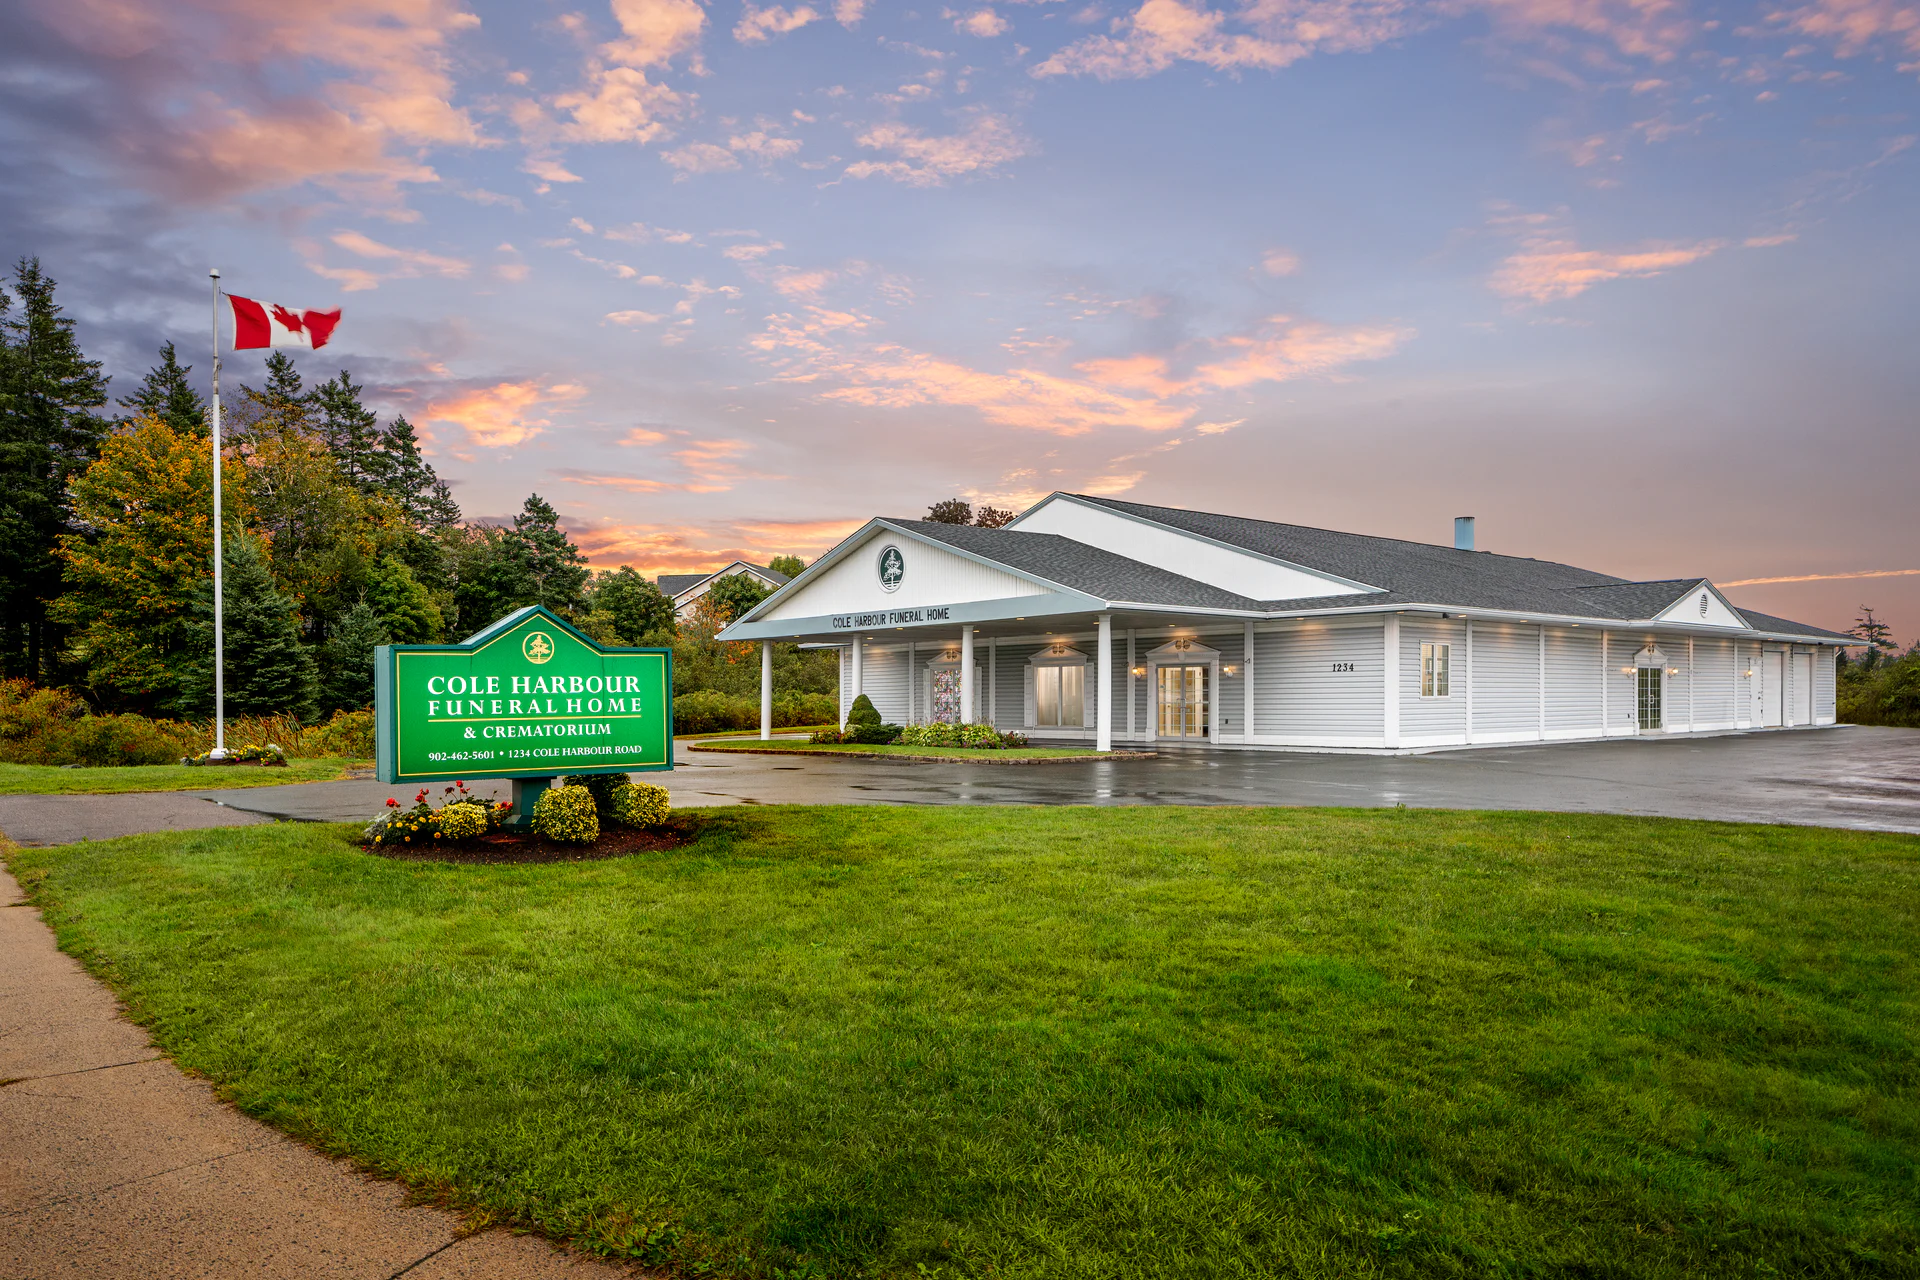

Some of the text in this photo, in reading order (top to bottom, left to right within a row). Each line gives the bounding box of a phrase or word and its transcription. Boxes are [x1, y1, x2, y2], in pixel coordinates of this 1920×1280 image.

[833, 608, 949, 628] COLE HARBOUR FUNERAL HOME
[1333, 663, 1354, 672] 1234
[427, 675, 641, 695] COLE HARBOUR
[427, 697, 642, 716] FUNERAL HOME
[463, 723, 612, 739] & CREMATORIUM
[428, 745, 642, 761] 902-462-5601 1234 COLE HARBOUR ROAD
